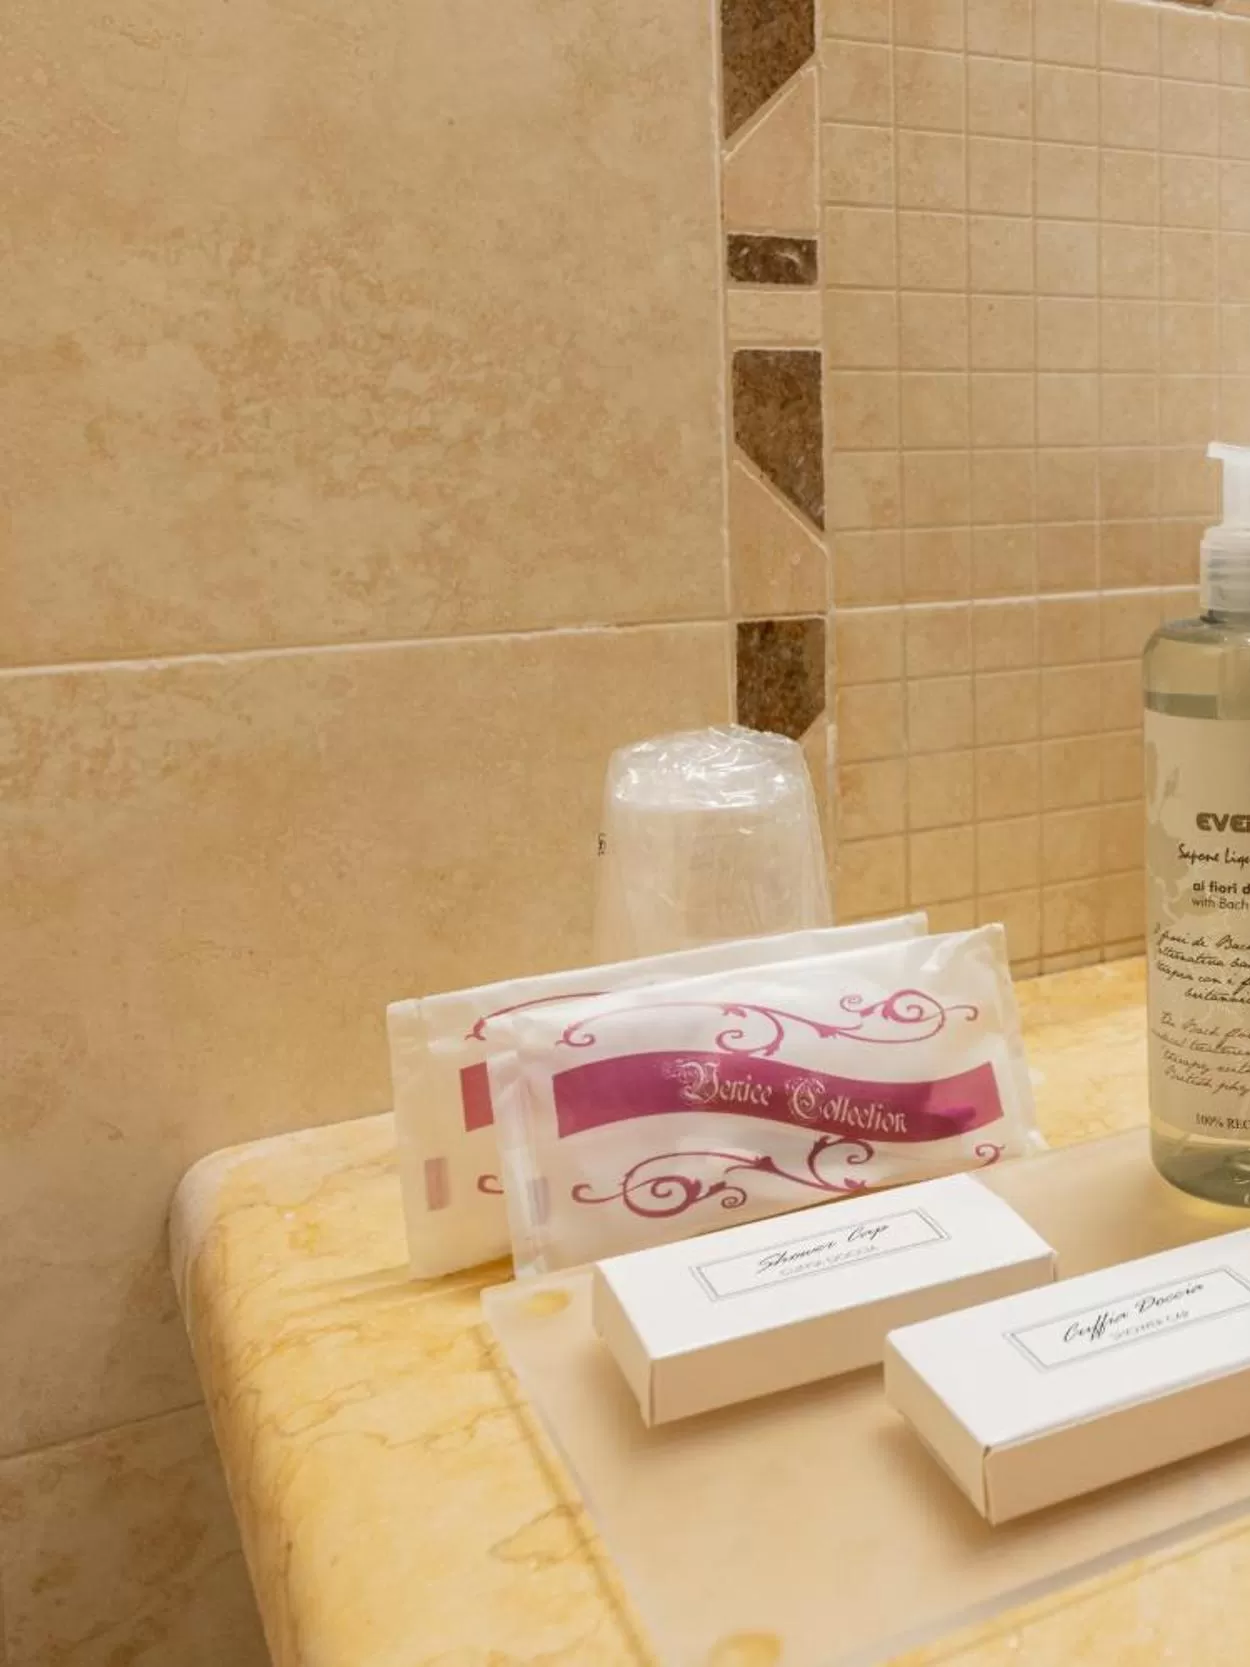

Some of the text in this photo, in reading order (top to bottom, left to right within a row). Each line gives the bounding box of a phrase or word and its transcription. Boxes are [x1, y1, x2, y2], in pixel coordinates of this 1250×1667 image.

[1178, 843, 1220, 865] Sapone
[1192, 881, 1205, 892] ai
[1209, 880, 1237, 894] fiori
[1192, 896, 1216, 909] with
[1219, 898, 1249, 911] Bach
[669, 1058, 907, 1134] Venice Collection
[1196, 1112, 1224, 1129] 100%
[756, 1241, 838, 1275] Shower
[847, 1223, 889, 1242] Cap
[1063, 1311, 1129, 1342] Cuffia
[1134, 1282, 1204, 1314] Doccia
